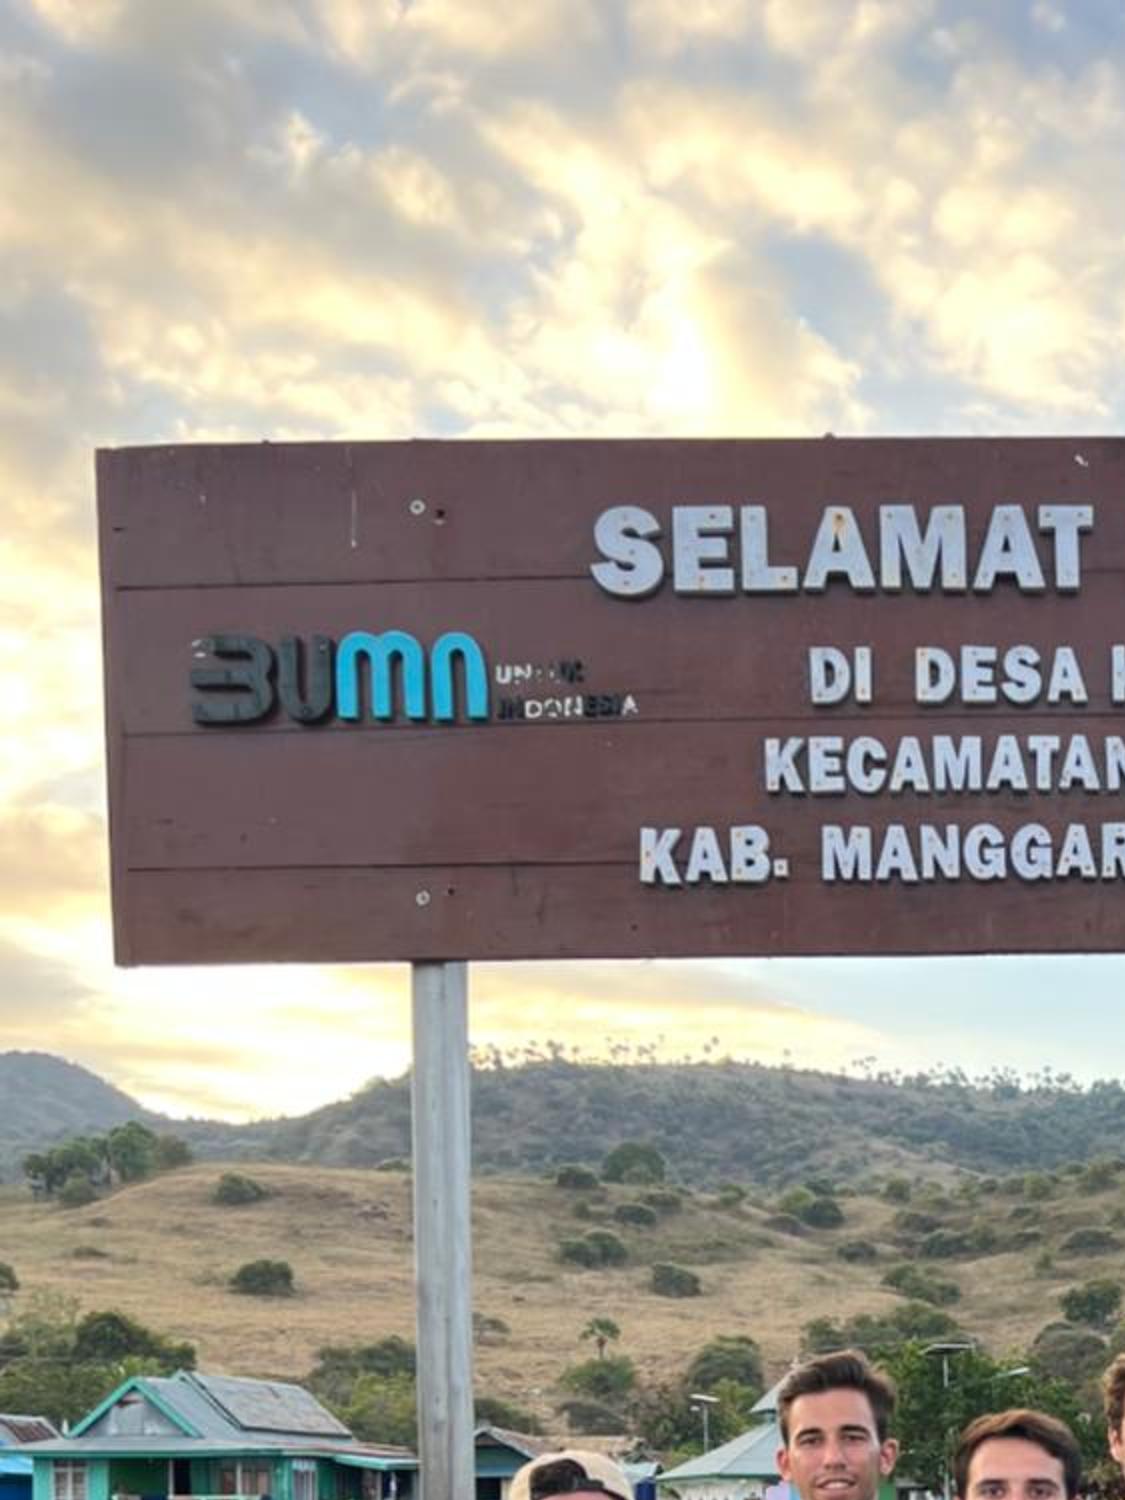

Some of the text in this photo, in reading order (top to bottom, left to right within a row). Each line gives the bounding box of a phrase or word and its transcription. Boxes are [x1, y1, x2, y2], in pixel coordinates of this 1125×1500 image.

[589, 505, 1094, 596] SELAMAT
[809, 646, 872, 704] DI
[915, 645, 1089, 704] DESA
[639, 825, 789, 886] KAB.
